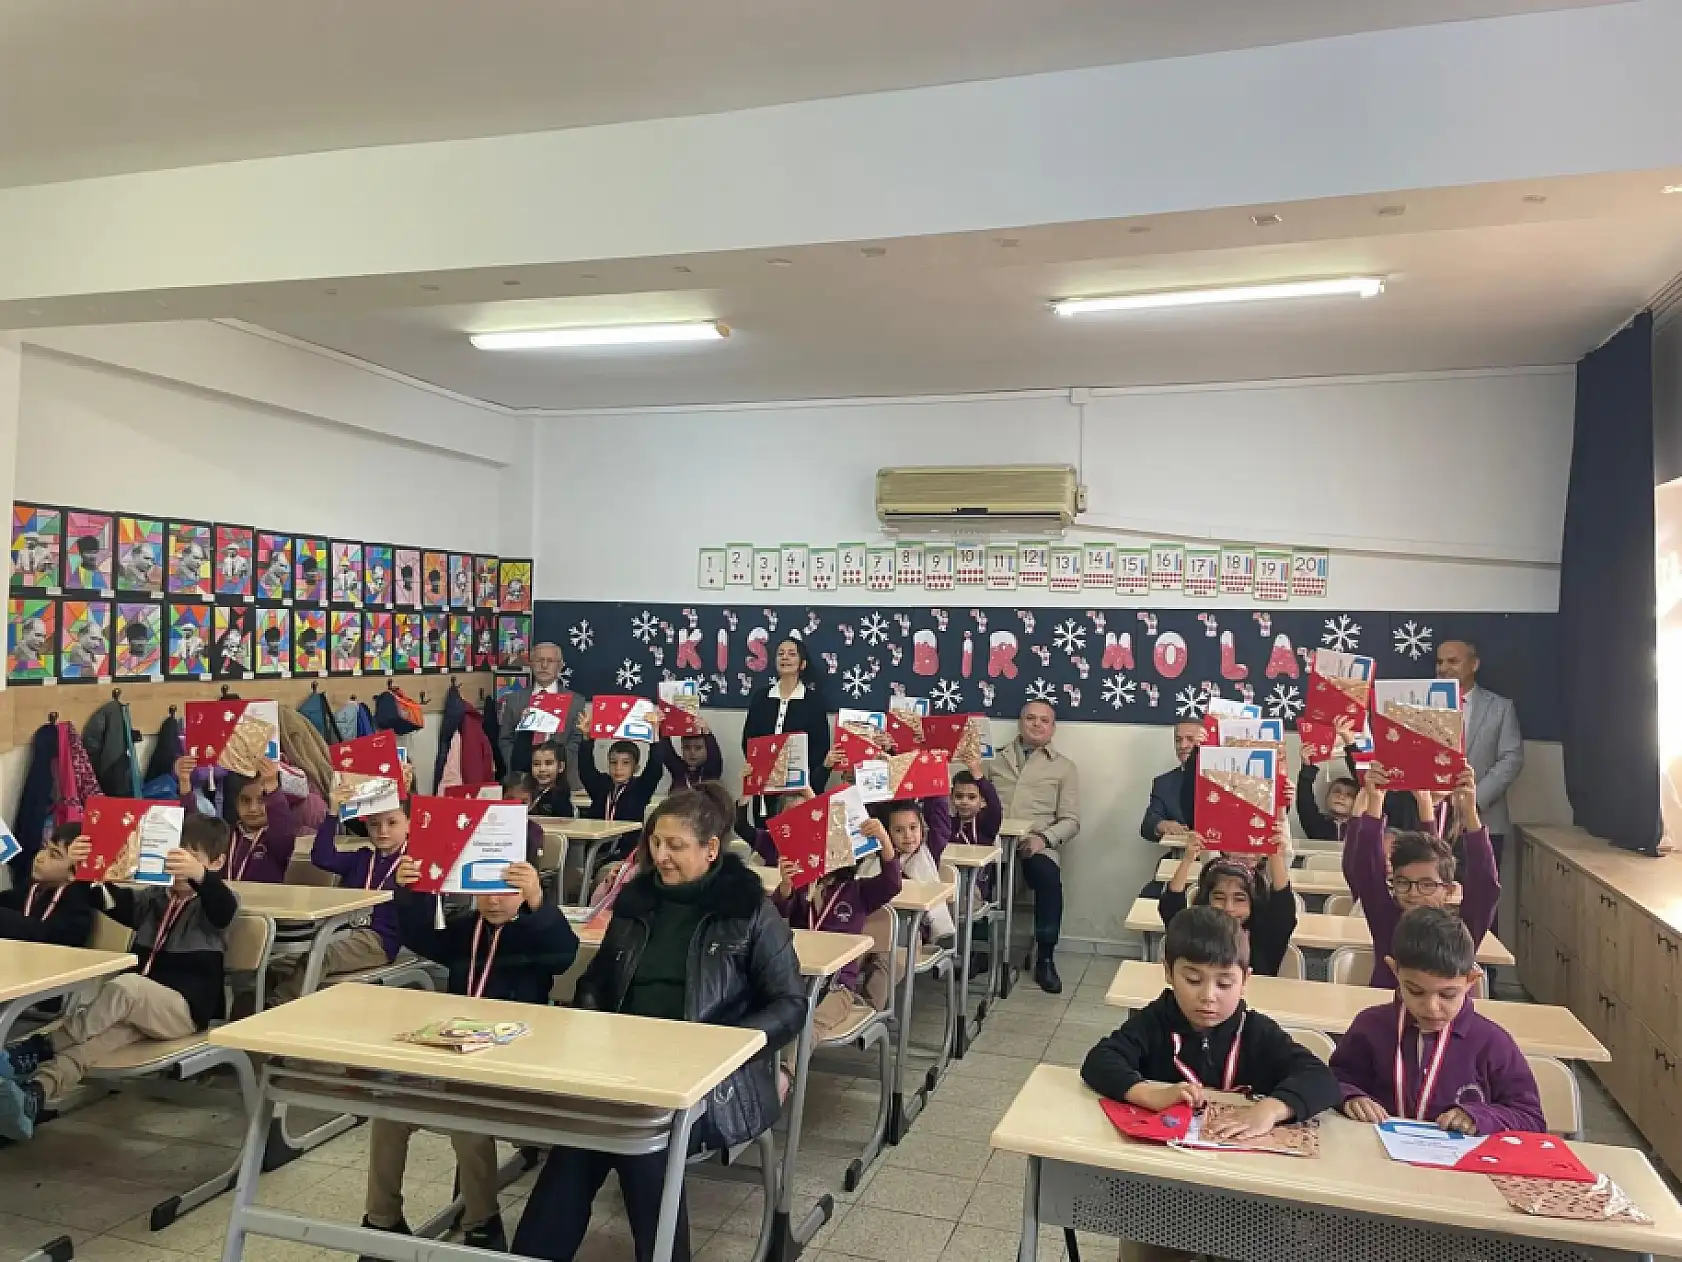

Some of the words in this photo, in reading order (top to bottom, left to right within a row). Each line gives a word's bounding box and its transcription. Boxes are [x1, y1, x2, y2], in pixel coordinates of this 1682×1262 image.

[707, 556, 713, 569] 1
[732, 551, 741, 564] 2
[759, 556, 769, 569] 3
[787, 551, 796, 564] 4
[816, 557, 825, 569] 5
[844, 551, 853, 564] 6
[873, 555, 882, 568] 7
[902, 550, 910, 563] 8
[933, 555, 941, 568] 9
[961, 549, 974, 563] 10
[994, 555, 1004, 568] 11
[1023, 549, 1039, 563] 12
[1056, 555, 1070, 569] 13
[1088, 551, 1103, 565] 14
[1156, 553, 1171, 567] 16
[1226, 555, 1241, 569] 18
[1122, 557, 1138, 571] 15
[1190, 558, 1206, 573] 17
[1261, 562, 1276, 576] 19
[1295, 557, 1317, 572] 20
[676, 628, 803, 672] KIS
[1101, 630, 1300, 680] MOLA
